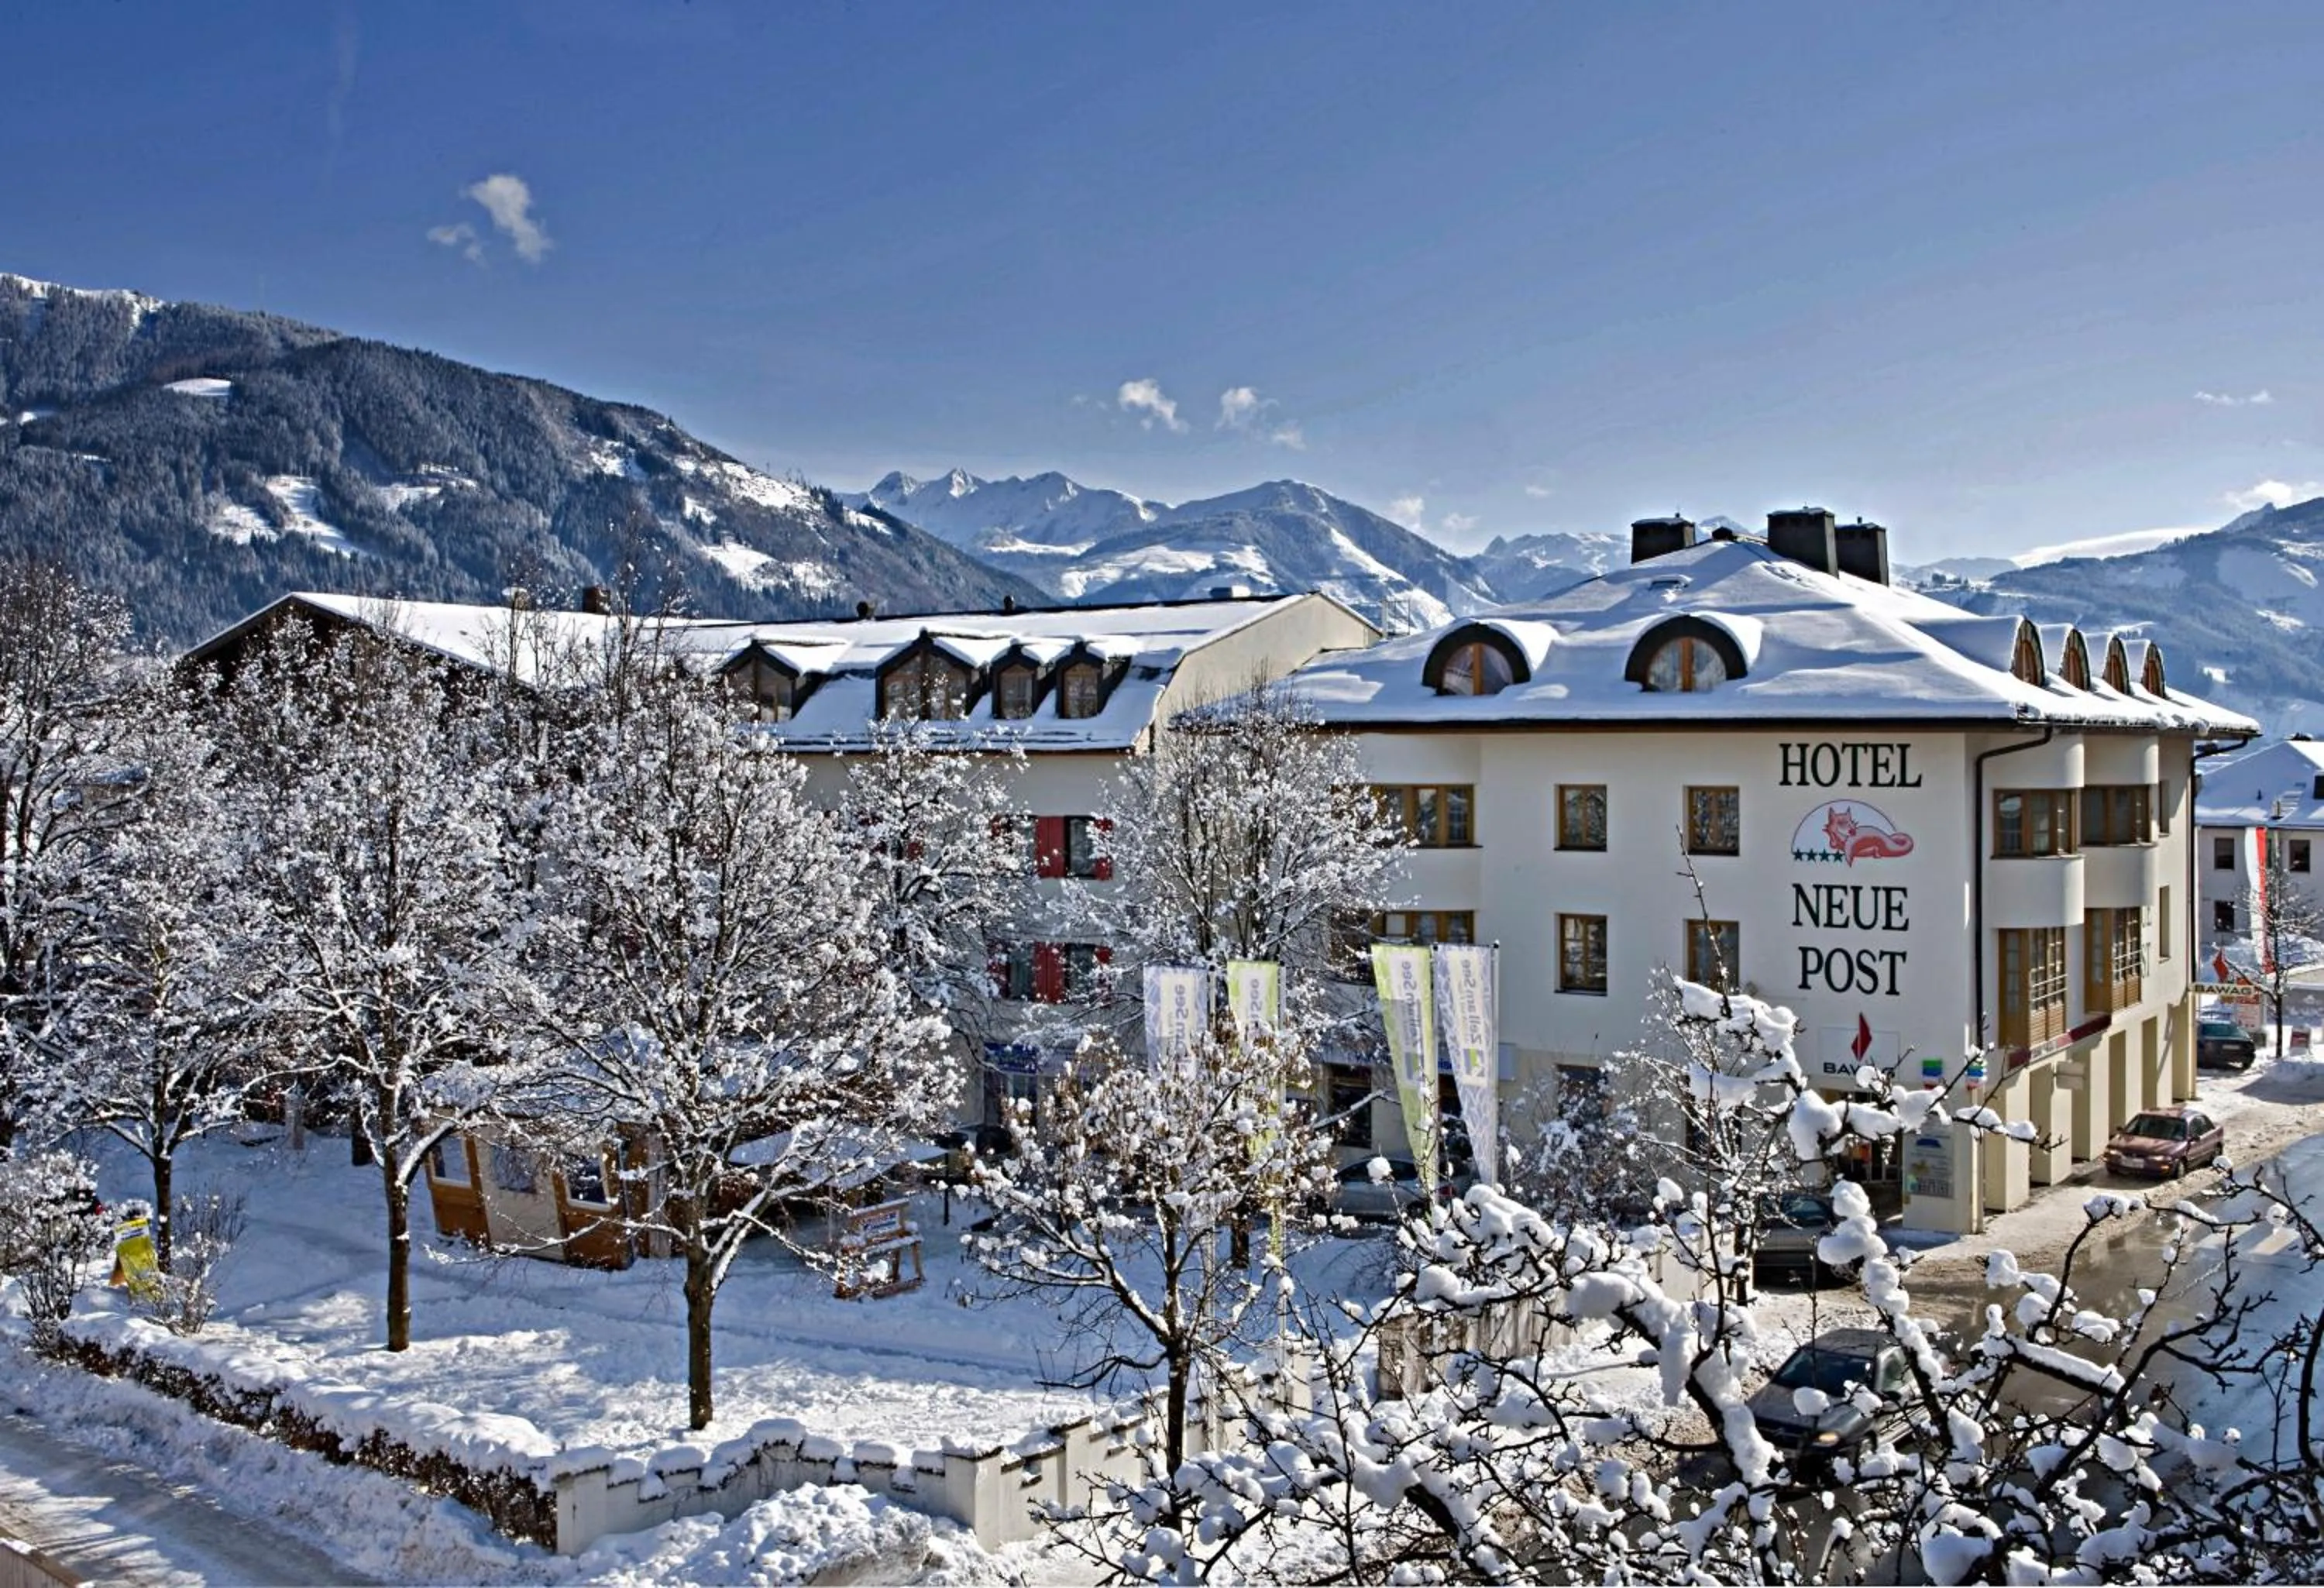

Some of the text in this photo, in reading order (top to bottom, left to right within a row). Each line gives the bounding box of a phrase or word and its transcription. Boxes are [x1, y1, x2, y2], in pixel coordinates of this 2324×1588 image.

[1779, 742, 1922, 788] HOTEL
[1792, 883, 1910, 931] NEUE
[1798, 946, 1907, 996] POST
[2195, 984, 2252, 995] BAWAG
[1824, 1062, 1895, 1078] BAWG
